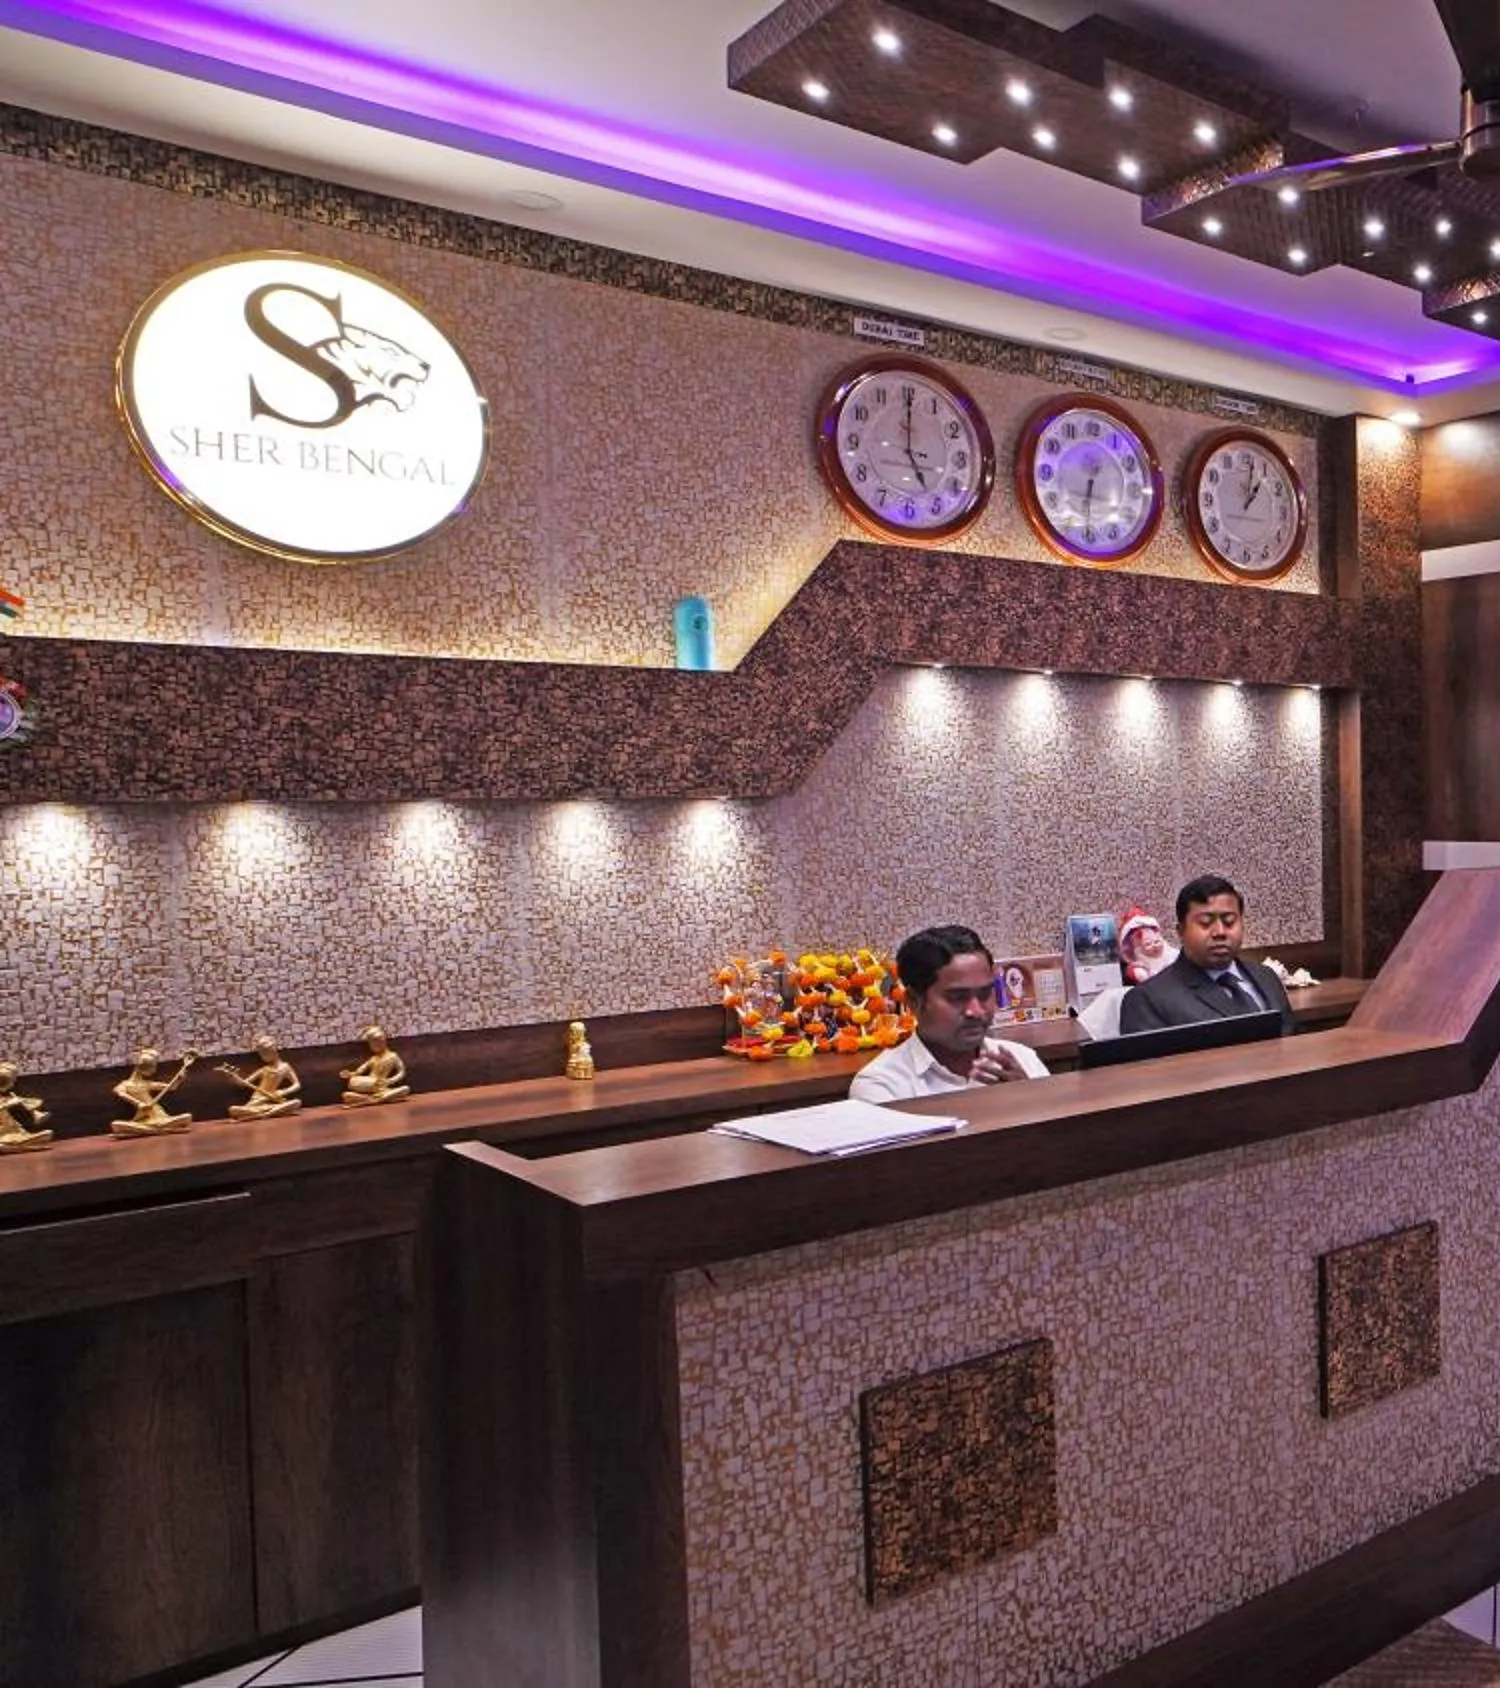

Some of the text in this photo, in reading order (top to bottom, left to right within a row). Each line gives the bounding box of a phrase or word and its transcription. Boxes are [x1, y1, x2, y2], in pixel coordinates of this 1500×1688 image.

[876, 387, 887, 406] 11
[855, 405, 869, 422] 10
[949, 421, 960, 439] 2
[1065, 423, 1076, 440] 11
[848, 433, 859, 450] 9
[169, 425, 457, 487] SHER BENGAL
[955, 451, 967, 469] 3
[856, 463, 867, 482] 8
[877, 489, 887, 507] 7
[931, 497, 941, 516] 5
[905, 498, 915, 519] 6
